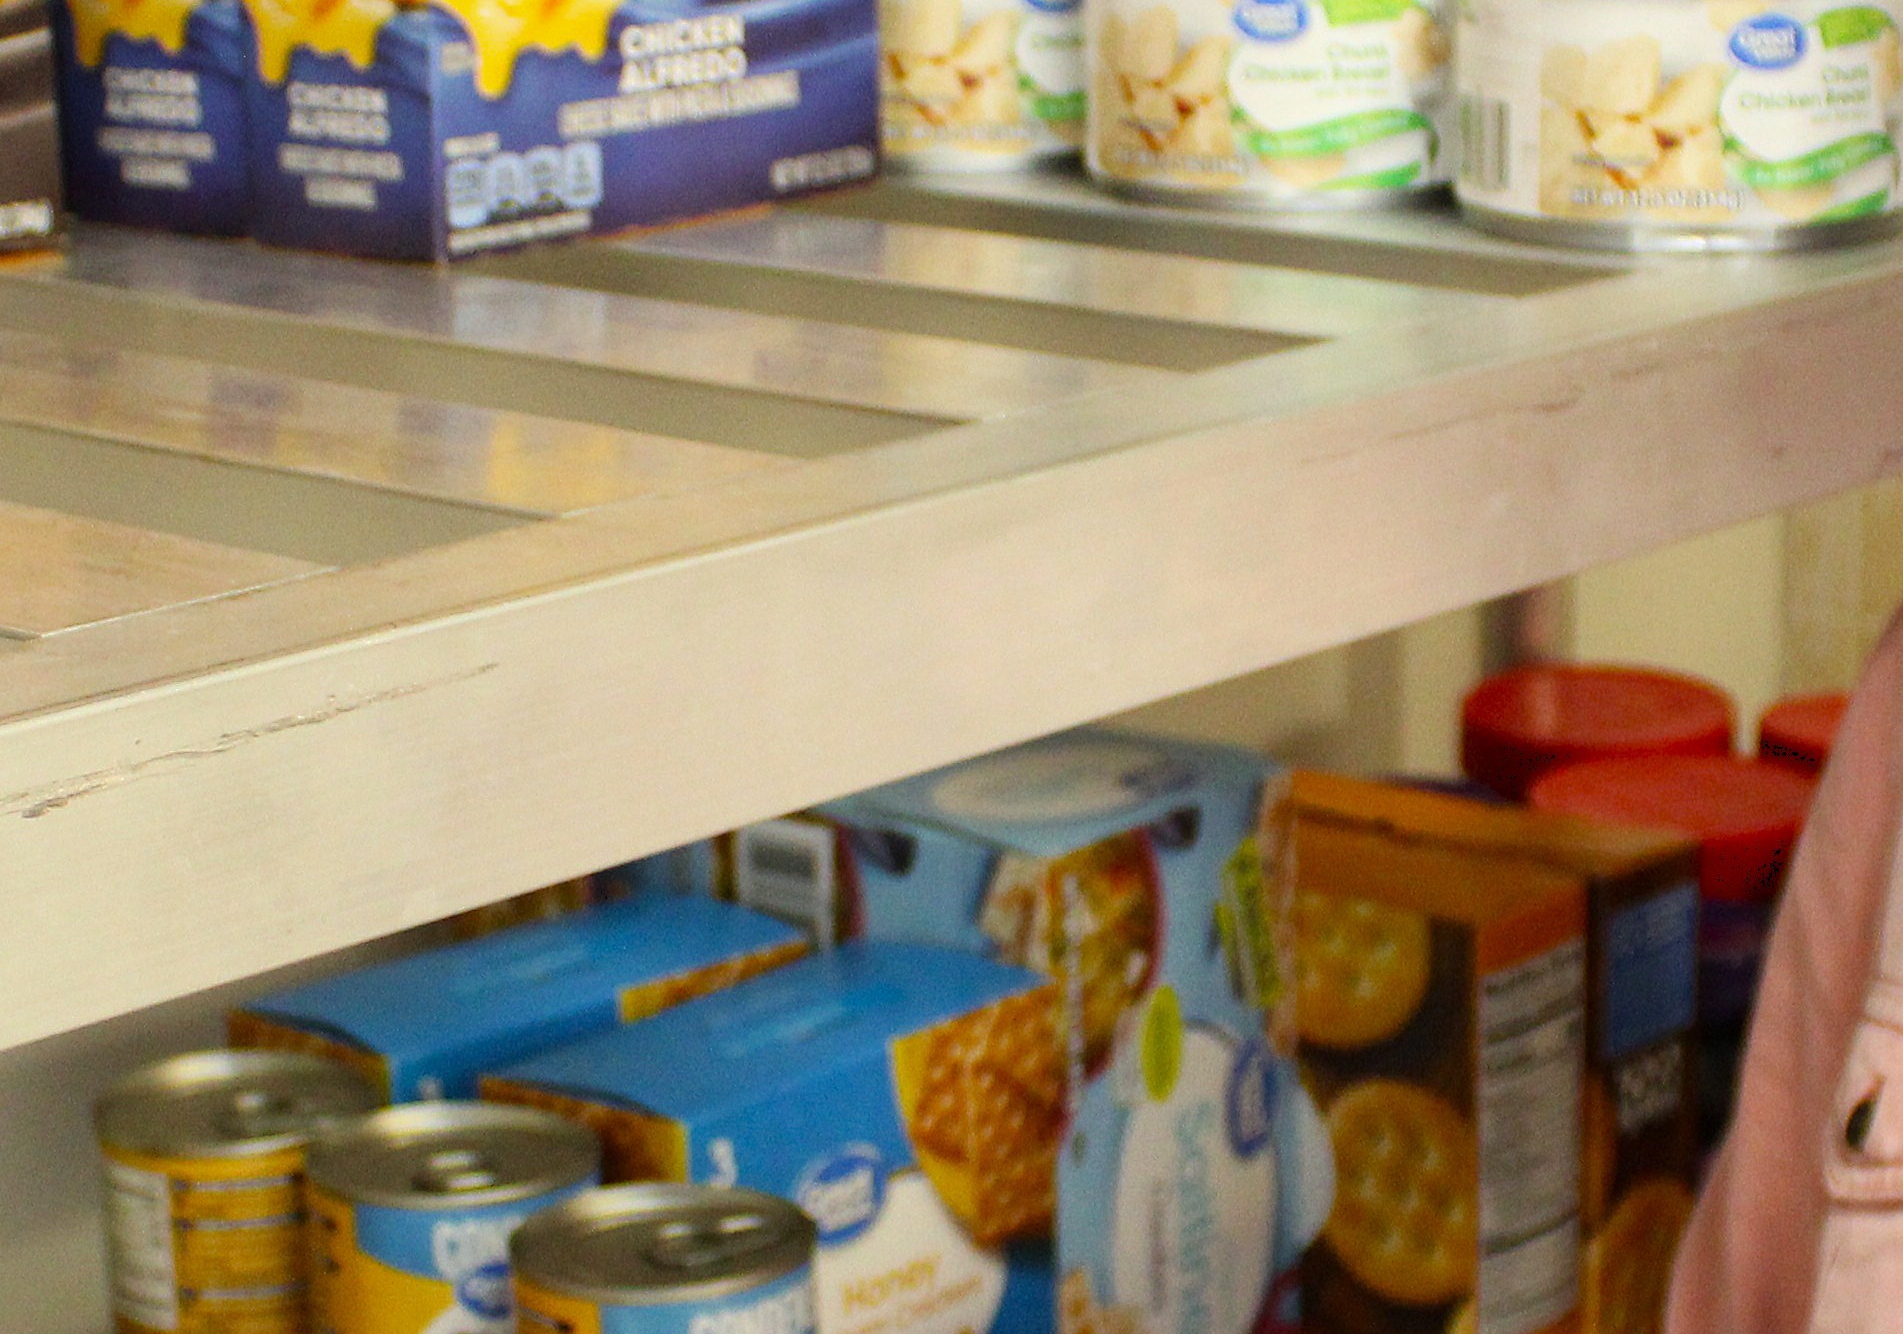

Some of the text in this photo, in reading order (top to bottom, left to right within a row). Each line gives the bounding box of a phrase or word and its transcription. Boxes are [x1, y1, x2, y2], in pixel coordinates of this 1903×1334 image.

[619, 13, 745, 59] CHICKEN
[617, 46, 748, 95] ALFREDO
[1738, 91, 1823, 110] Chicken
